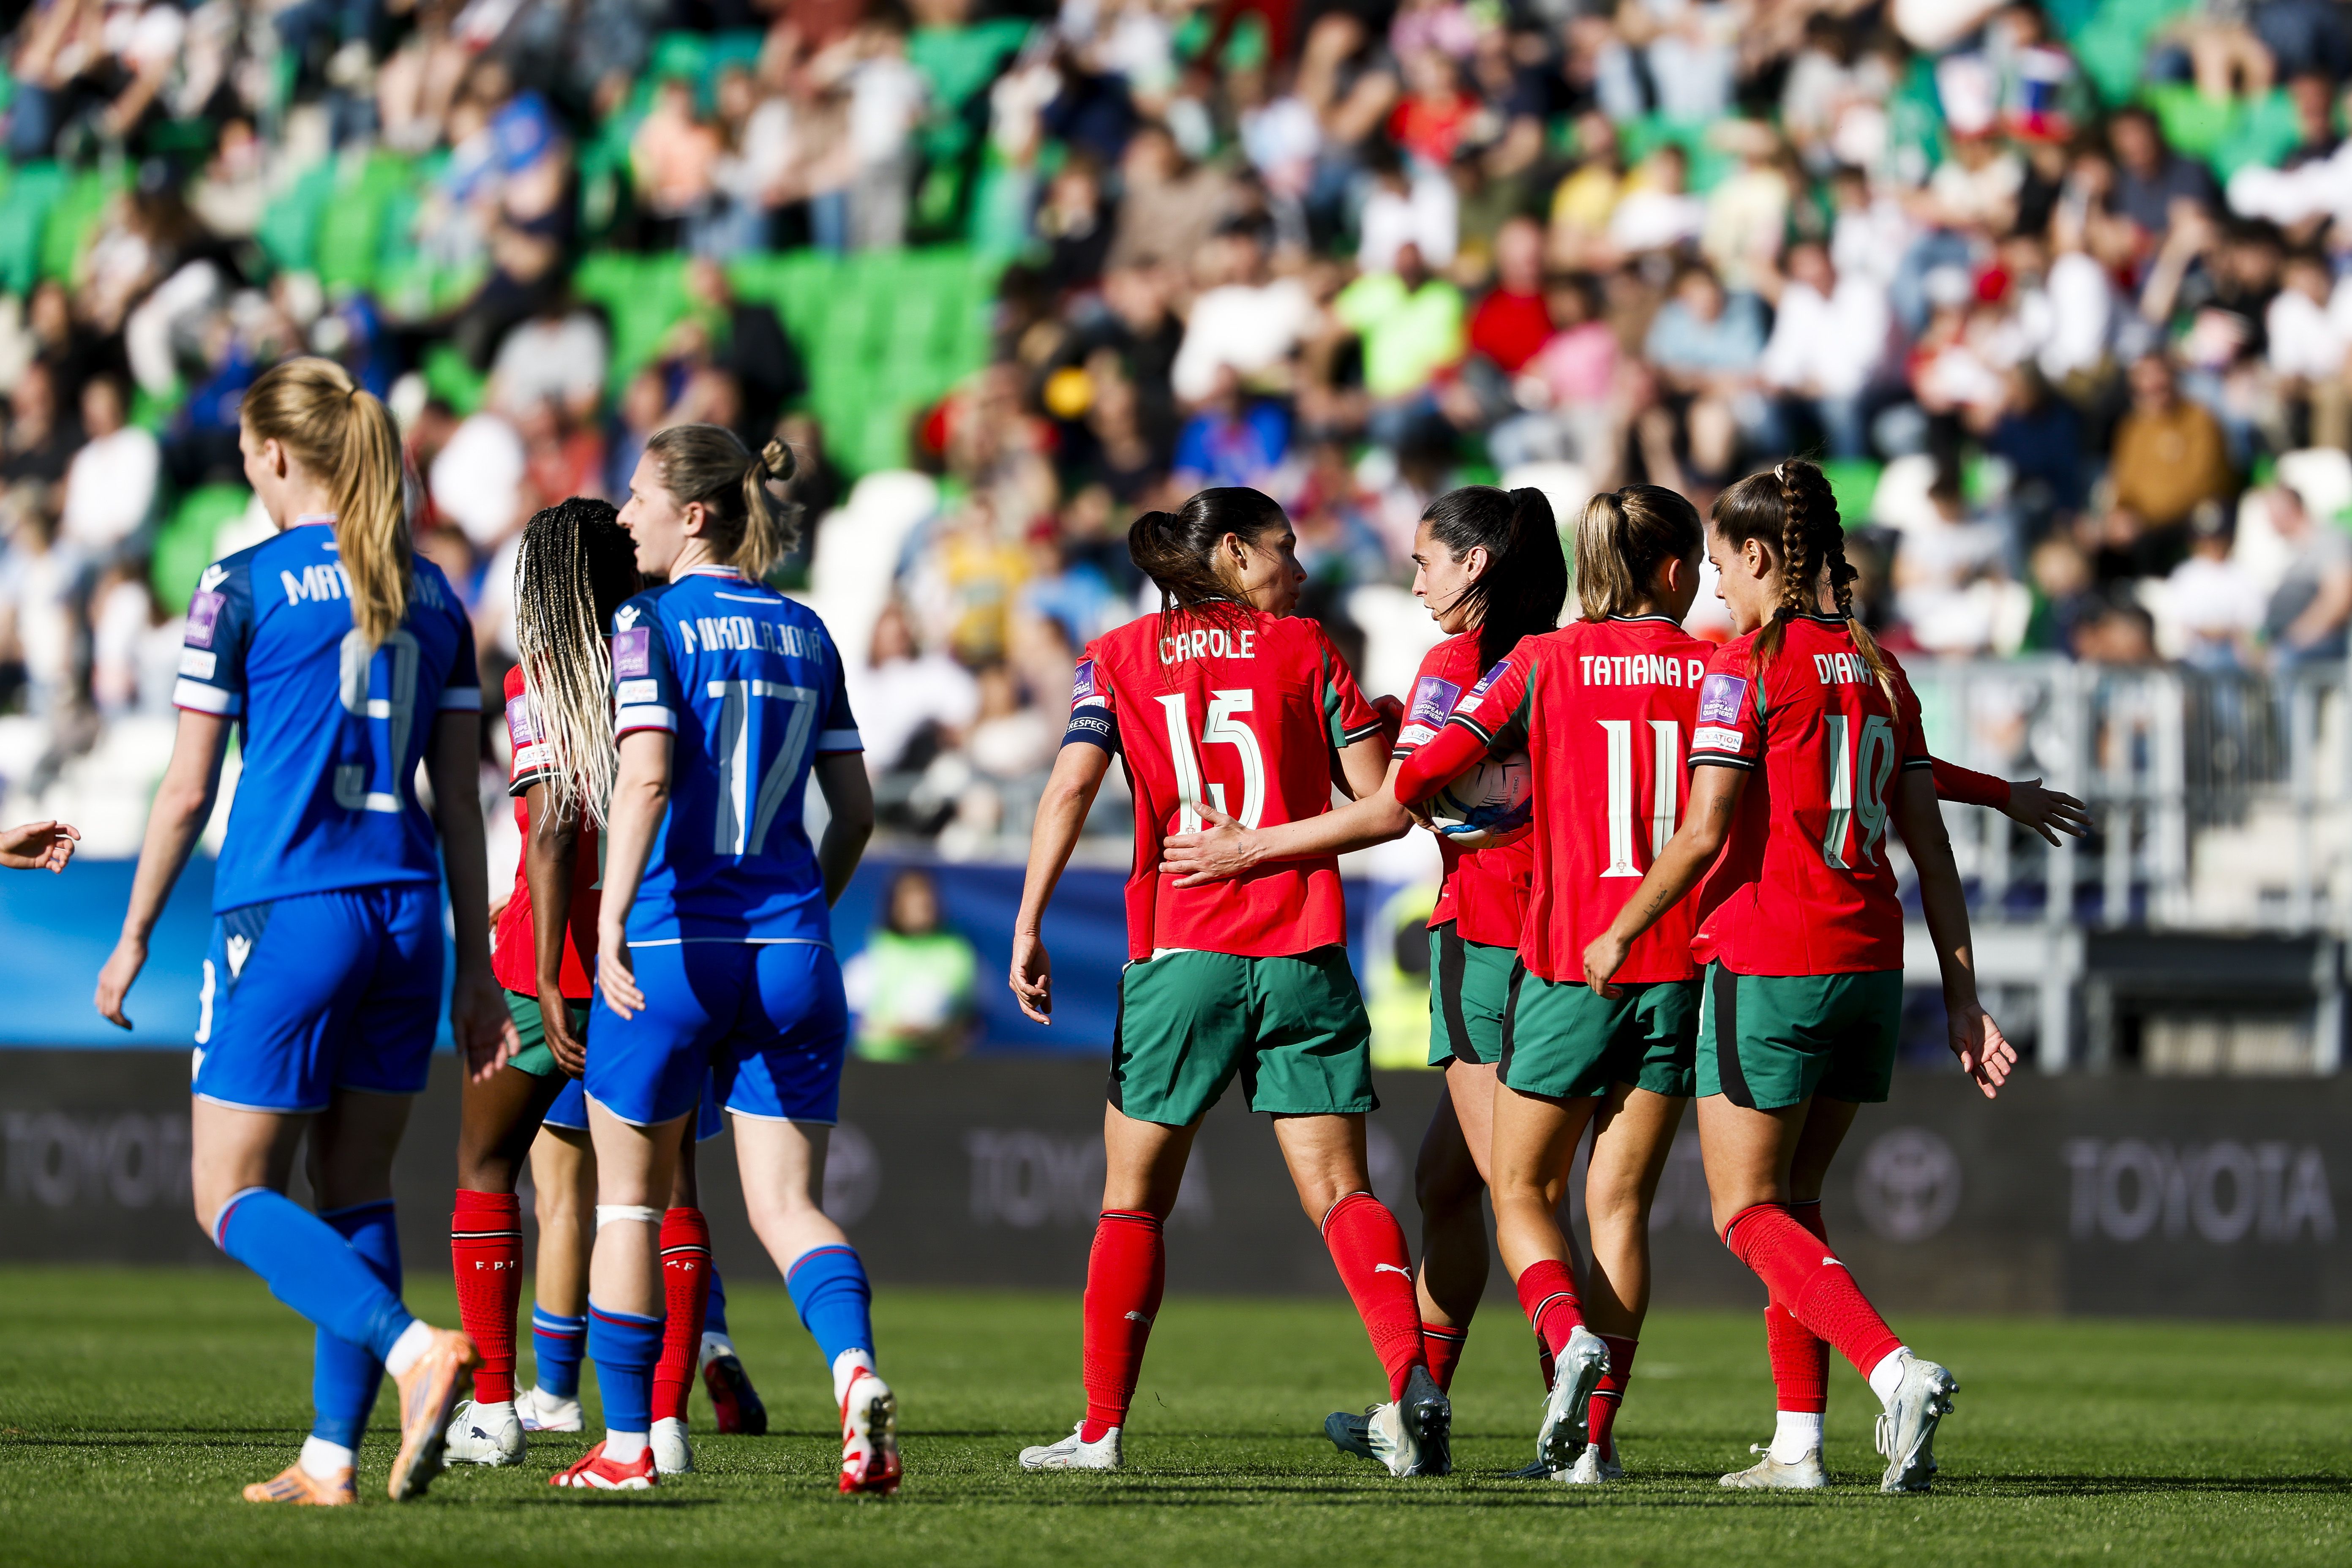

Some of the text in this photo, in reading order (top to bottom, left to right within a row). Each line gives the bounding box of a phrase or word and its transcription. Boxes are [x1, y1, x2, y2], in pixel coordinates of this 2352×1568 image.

[1159, 629, 1254, 665] CAROLE
[1580, 654, 1681, 687] TATIANA
[1813, 652, 1873, 687] DIANA
[333, 627, 420, 813] 9
[1413, 709, 1443, 722] QUALIFIERS
[1415, 704, 1444, 717] EUROPEAN
[1703, 709, 1733, 718] QUALIFIERS
[1704, 703, 1734, 712] EUROPEAN
[1068, 719, 1110, 733] RESPECT
[707, 679, 818, 856] 17
[1154, 689, 1265, 836] 15
[1597, 720, 1679, 878] 11
[1824, 714, 1895, 869] 19
[3, 1111, 191, 1207] TOYOT
[2063, 1137, 2336, 1243] TOYOTA
